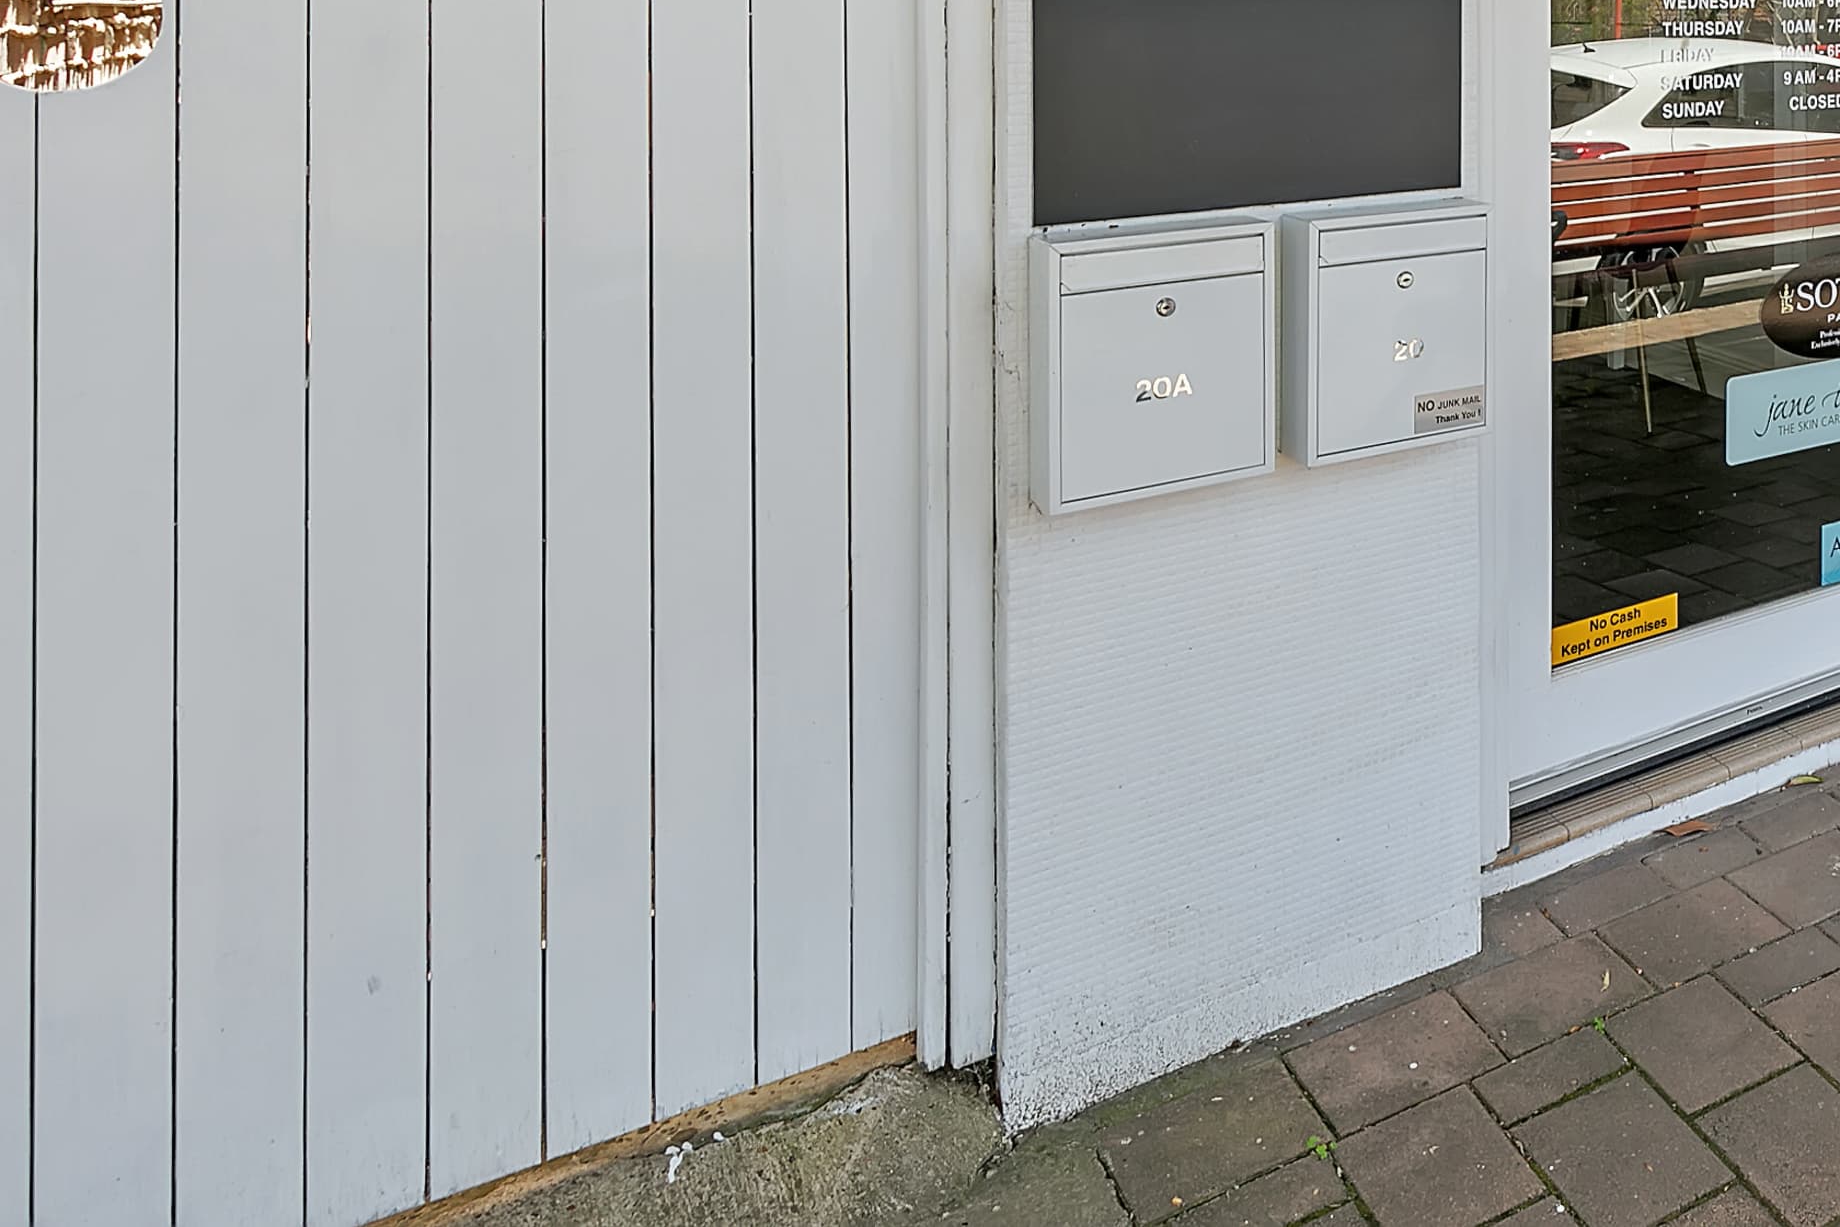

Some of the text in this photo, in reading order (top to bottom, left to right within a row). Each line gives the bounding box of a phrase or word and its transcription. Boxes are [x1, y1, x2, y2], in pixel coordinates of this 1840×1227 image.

[1662, 20, 1744, 37] THURSDAY
[1781, 19, 1816, 33] 10AM
[1661, 73, 1743, 91] SATURDAY
[1662, 100, 1724, 119] SUNDAY
[1394, 339, 1424, 362] 20
[1135, 374, 1193, 403] 20A
[1418, 395, 1482, 413] NO JUNK MAIL
[1435, 413, 1459, 424] Thank
[1462, 411, 1476, 419] You
[1754, 394, 1816, 437] jane
[1778, 422, 1794, 436] THE
[1798, 419, 1819, 432] SKIN
[1589, 608, 1641, 632] No Cash
[1561, 616, 1667, 657] Kept on Premises
